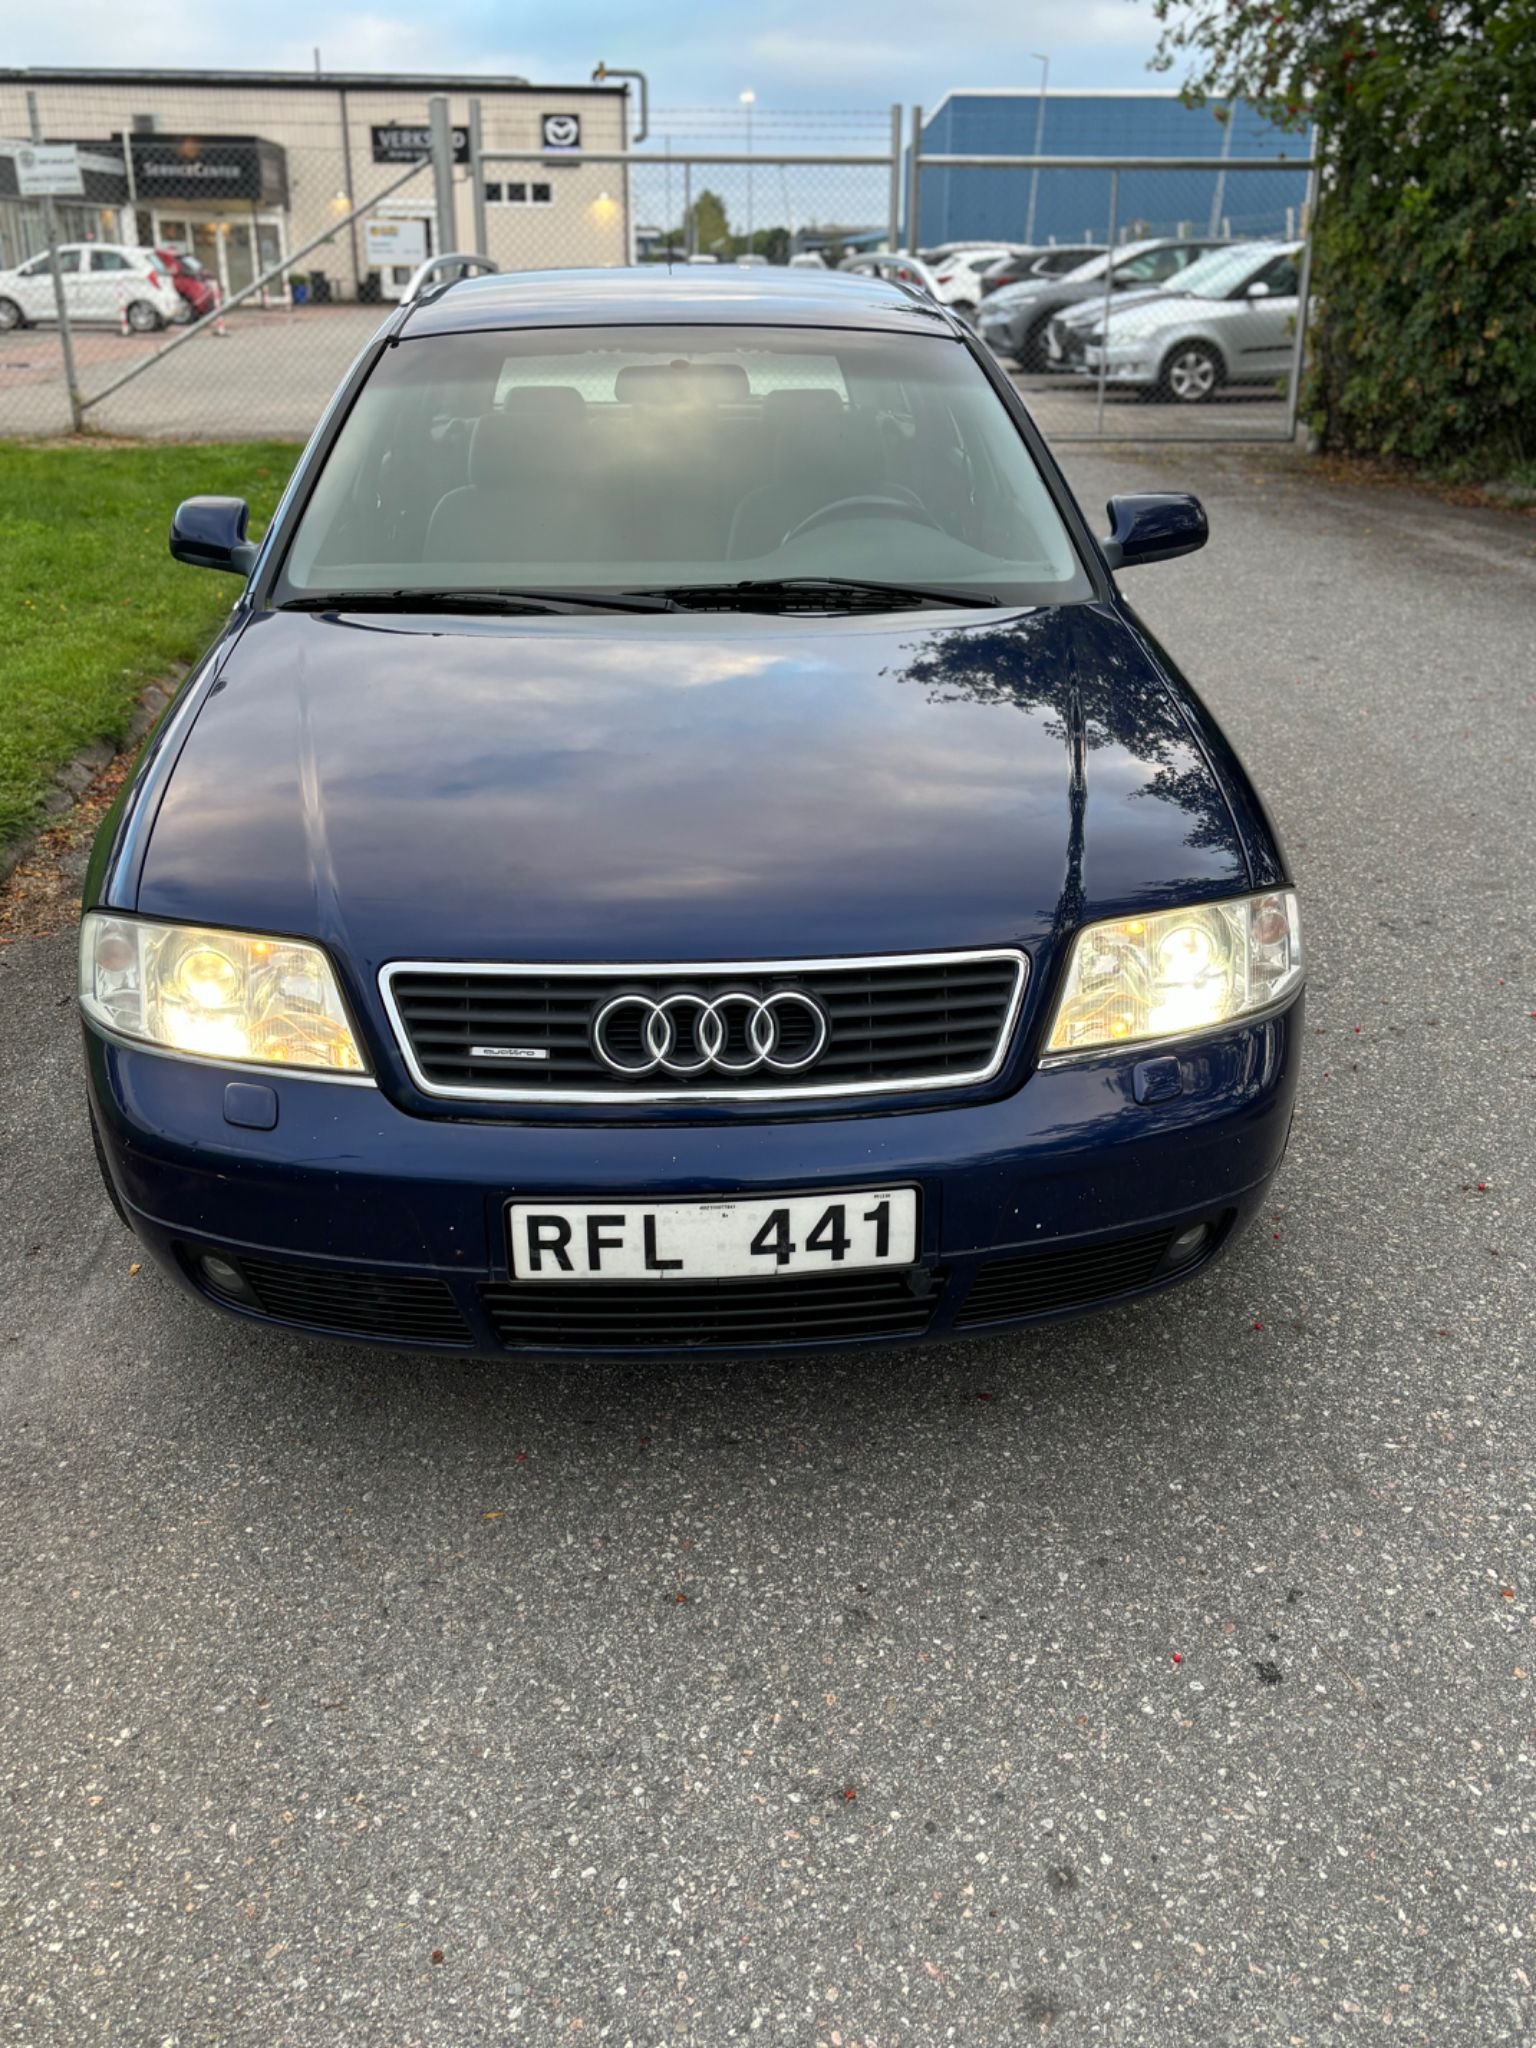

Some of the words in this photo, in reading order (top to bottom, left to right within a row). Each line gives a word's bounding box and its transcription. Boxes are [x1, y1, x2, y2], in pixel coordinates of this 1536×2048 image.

[377, 130, 466, 149] VERKSD
[483, 1048, 536, 1057] quattro
[526, 1214, 684, 1272] RFL
[749, 1200, 891, 1266] 441
